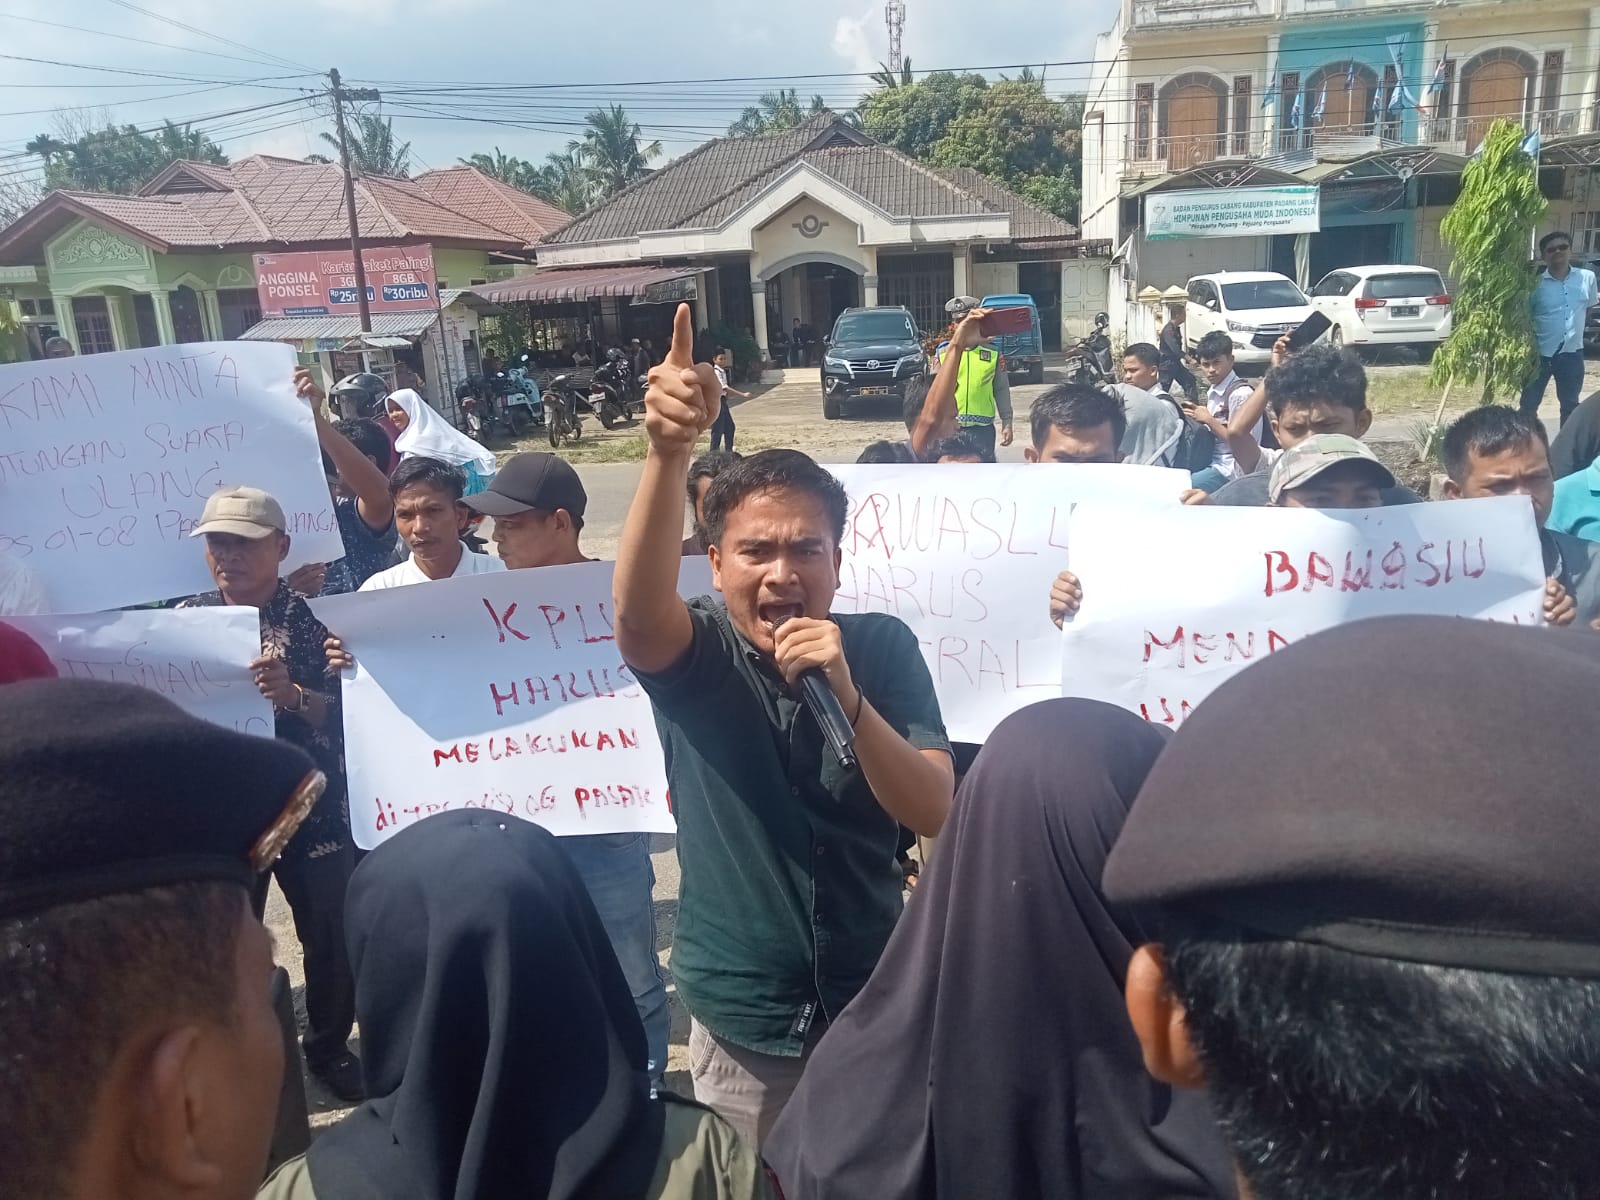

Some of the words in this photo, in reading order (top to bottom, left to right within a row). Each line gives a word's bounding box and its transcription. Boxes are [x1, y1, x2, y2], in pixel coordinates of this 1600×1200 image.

[1220, 202, 1242, 210] CABANG
[1242, 200, 1274, 209] KABUPATEN
[1173, 213, 1210, 223] HIMPUNAN
[1211, 210, 1252, 221] PENGUSAHA
[1253, 209, 1274, 219] MUDA
[1275, 207, 1316, 218] INDONESIA
[364, 258, 392, 272] aket
[259, 271, 318, 286] ANGGINA
[392, 273, 415, 284] 8GB
[268, 284, 320, 298] PONSEL
[0, 371, 103, 429] KAMI
[129, 351, 240, 405] MINTA
[483, 598, 614, 650] KPU
[490, 664, 640, 716] HARUS
[434, 728, 640, 767] MELAKUKAN
